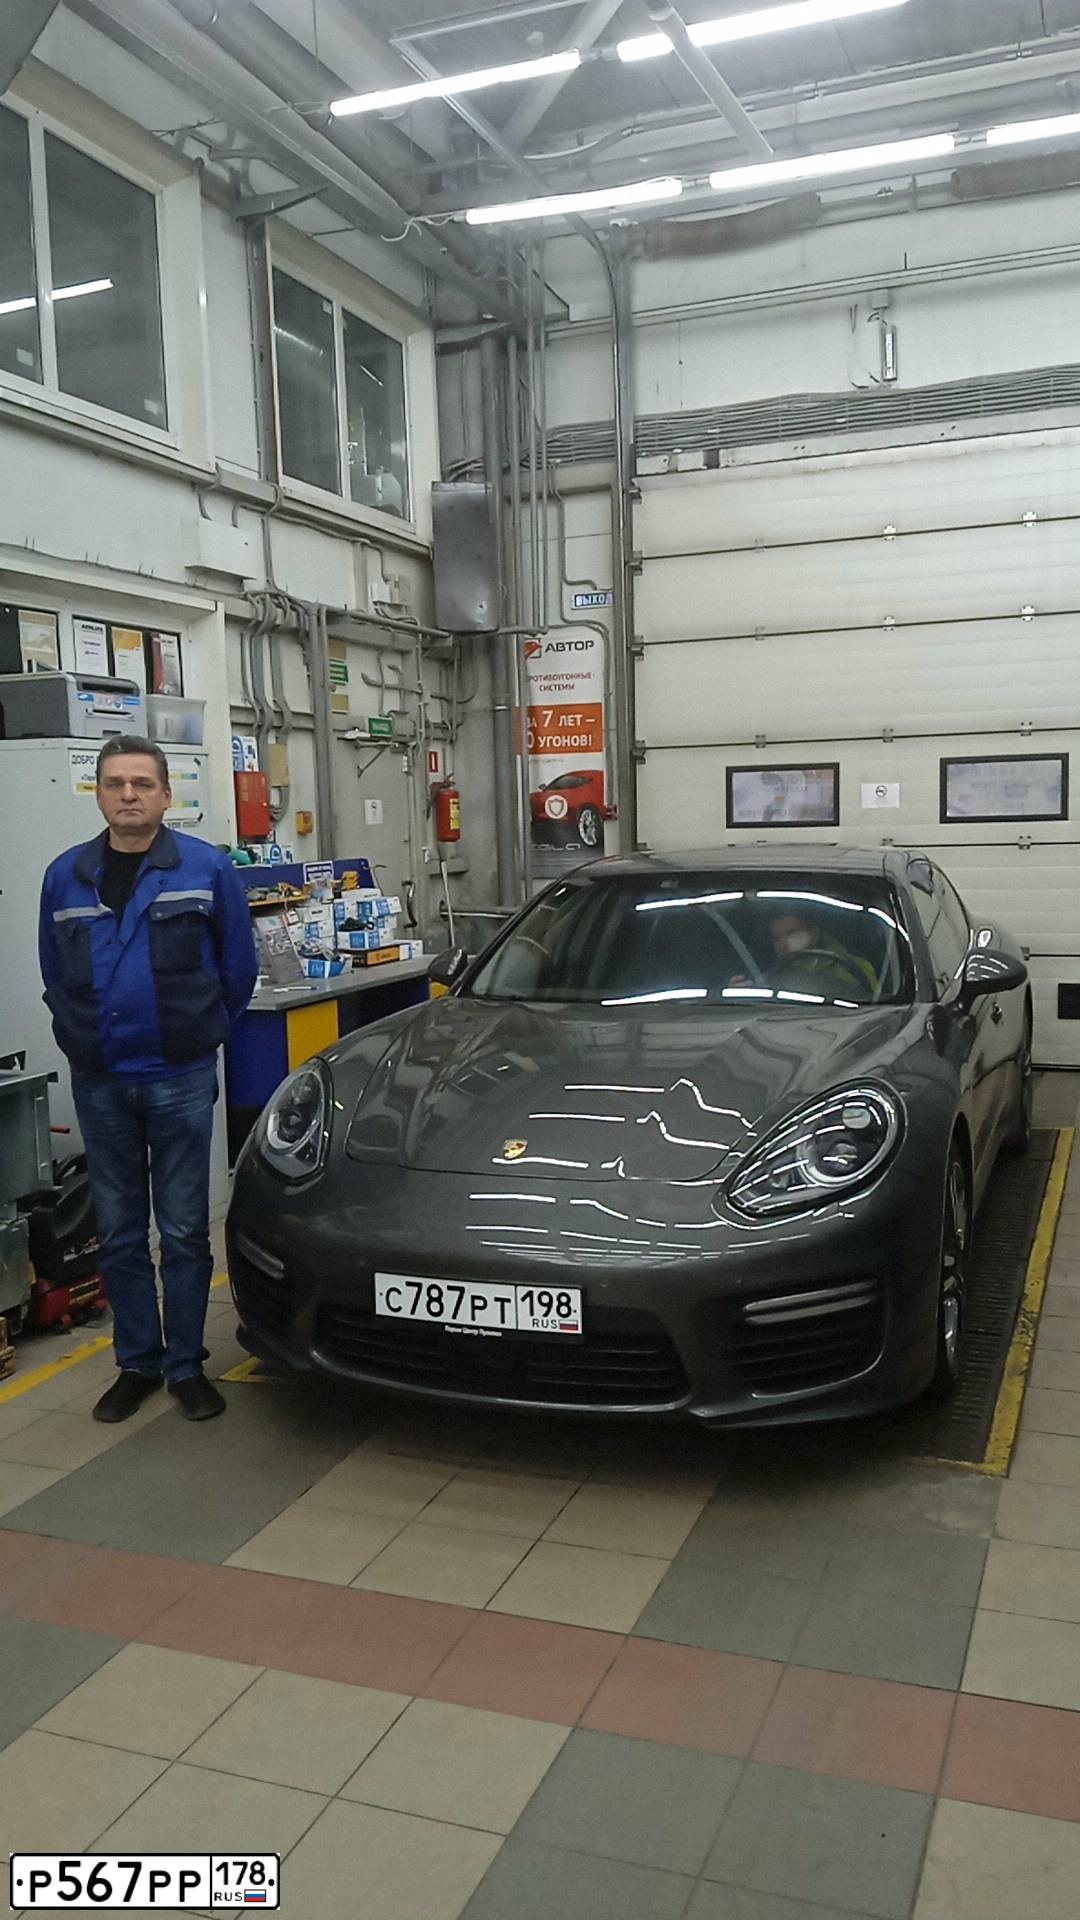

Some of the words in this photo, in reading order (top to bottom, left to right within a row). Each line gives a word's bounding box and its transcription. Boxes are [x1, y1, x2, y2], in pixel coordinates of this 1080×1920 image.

[545, 640, 595, 653] АВТОР
[538, 683, 576, 692] СИСТЕМЫ
[541, 709, 554, 728] 7
[558, 714, 584, 728] ЛЕТ
[537, 734, 593, 748] УГОНОВ!
[520, 1290, 572, 1319] 198
[532, 1318, 558, 1329] RUS
